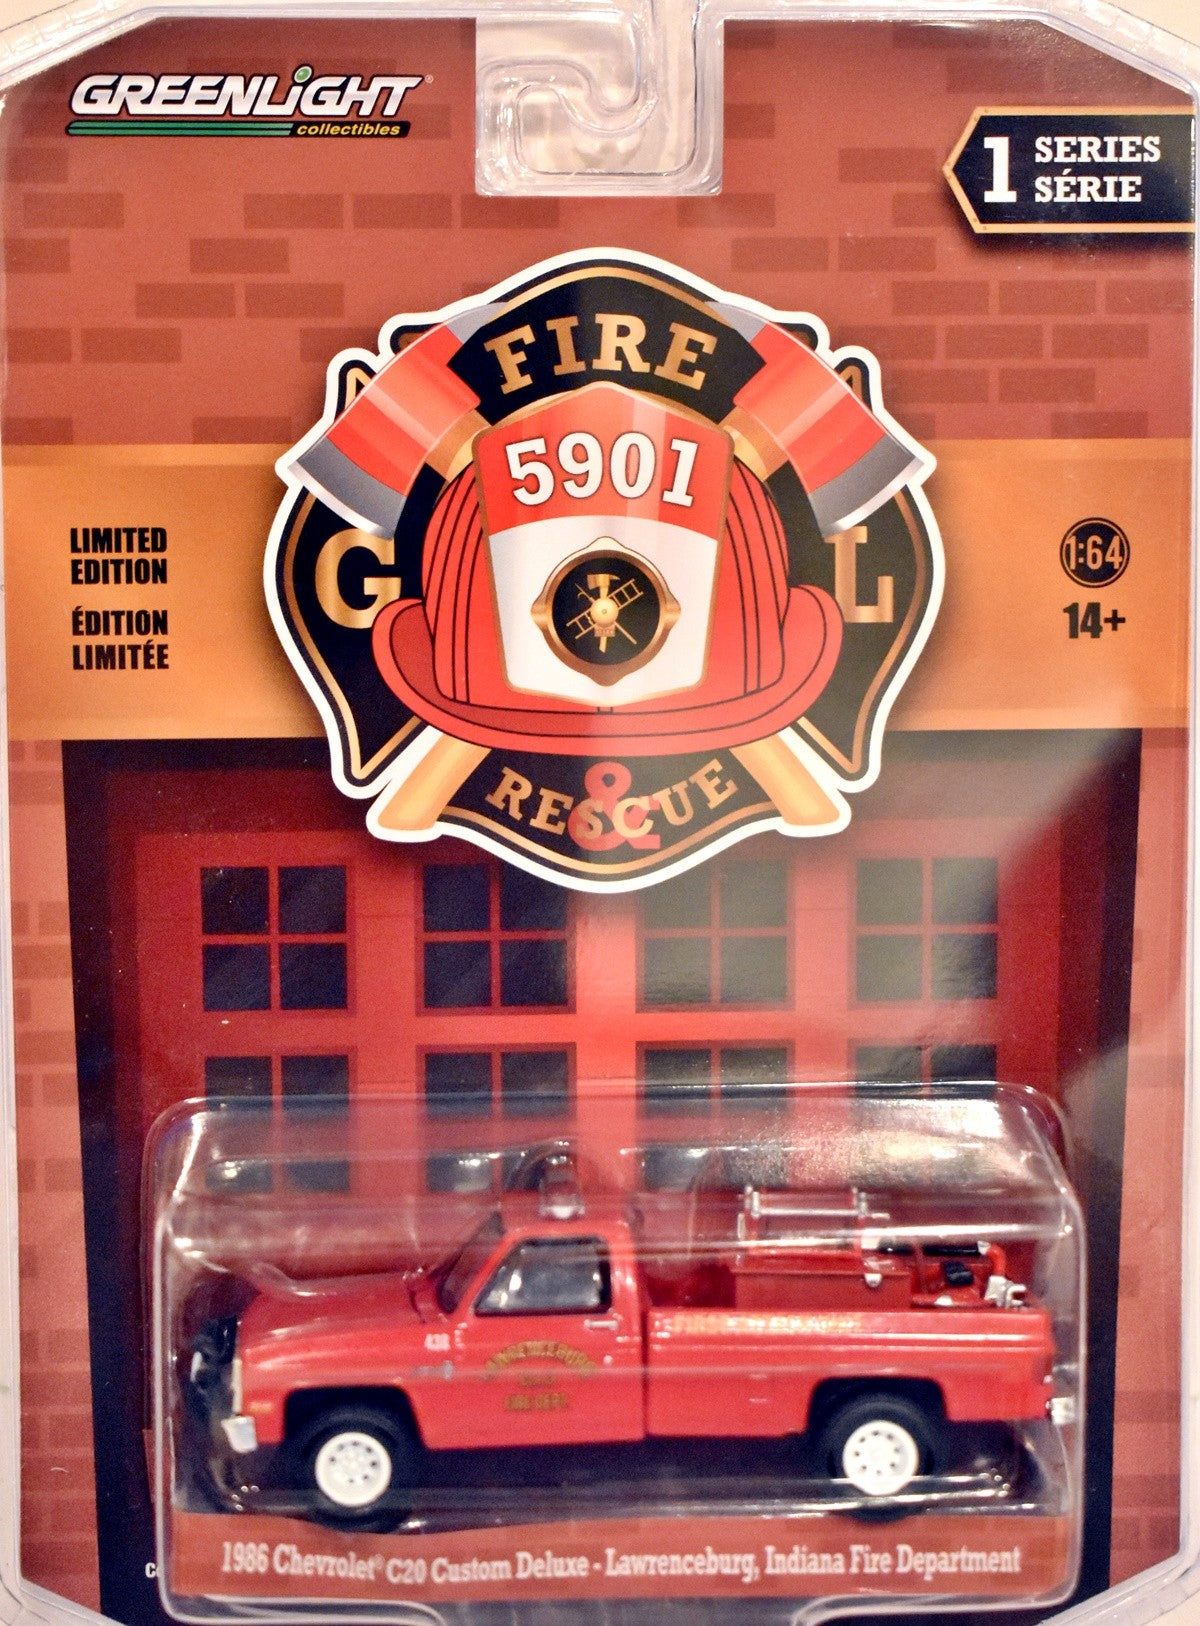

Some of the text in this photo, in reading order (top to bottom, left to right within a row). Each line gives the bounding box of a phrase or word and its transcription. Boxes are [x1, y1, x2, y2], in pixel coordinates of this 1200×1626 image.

[296, 123, 401, 136] collectibles
[1034, 136, 1161, 163] SERIES
[983, 136, 1017, 203] 1
[1034, 168, 1142, 203] SÉRIE
[483, 312, 718, 395] FIRE
[505, 431, 699, 507] 5901
[70, 527, 168, 553] LIMITED
[1065, 535, 1123, 570] 1:64
[71, 558, 168, 585] EDITION
[314, 527, 402, 629] G
[824, 525, 894, 623] L
[72, 605, 169, 636] ÉDITION
[1062, 602, 1127, 639] 14+
[72, 639, 170, 671] LIMITÉE
[484, 758, 739, 840] RESCUE
[222, 1541, 269, 1574] 1986
[385, 1557, 427, 1585] C20
[431, 1556, 512, 1583] Custom
[515, 1551, 589, 1580] Deluxe
[604, 1547, 760, 1583] Lawrenceburg,
[764, 1545, 845, 1576] Indiana
[849, 1544, 893, 1575] Fire
[896, 1544, 1021, 1581] Department
